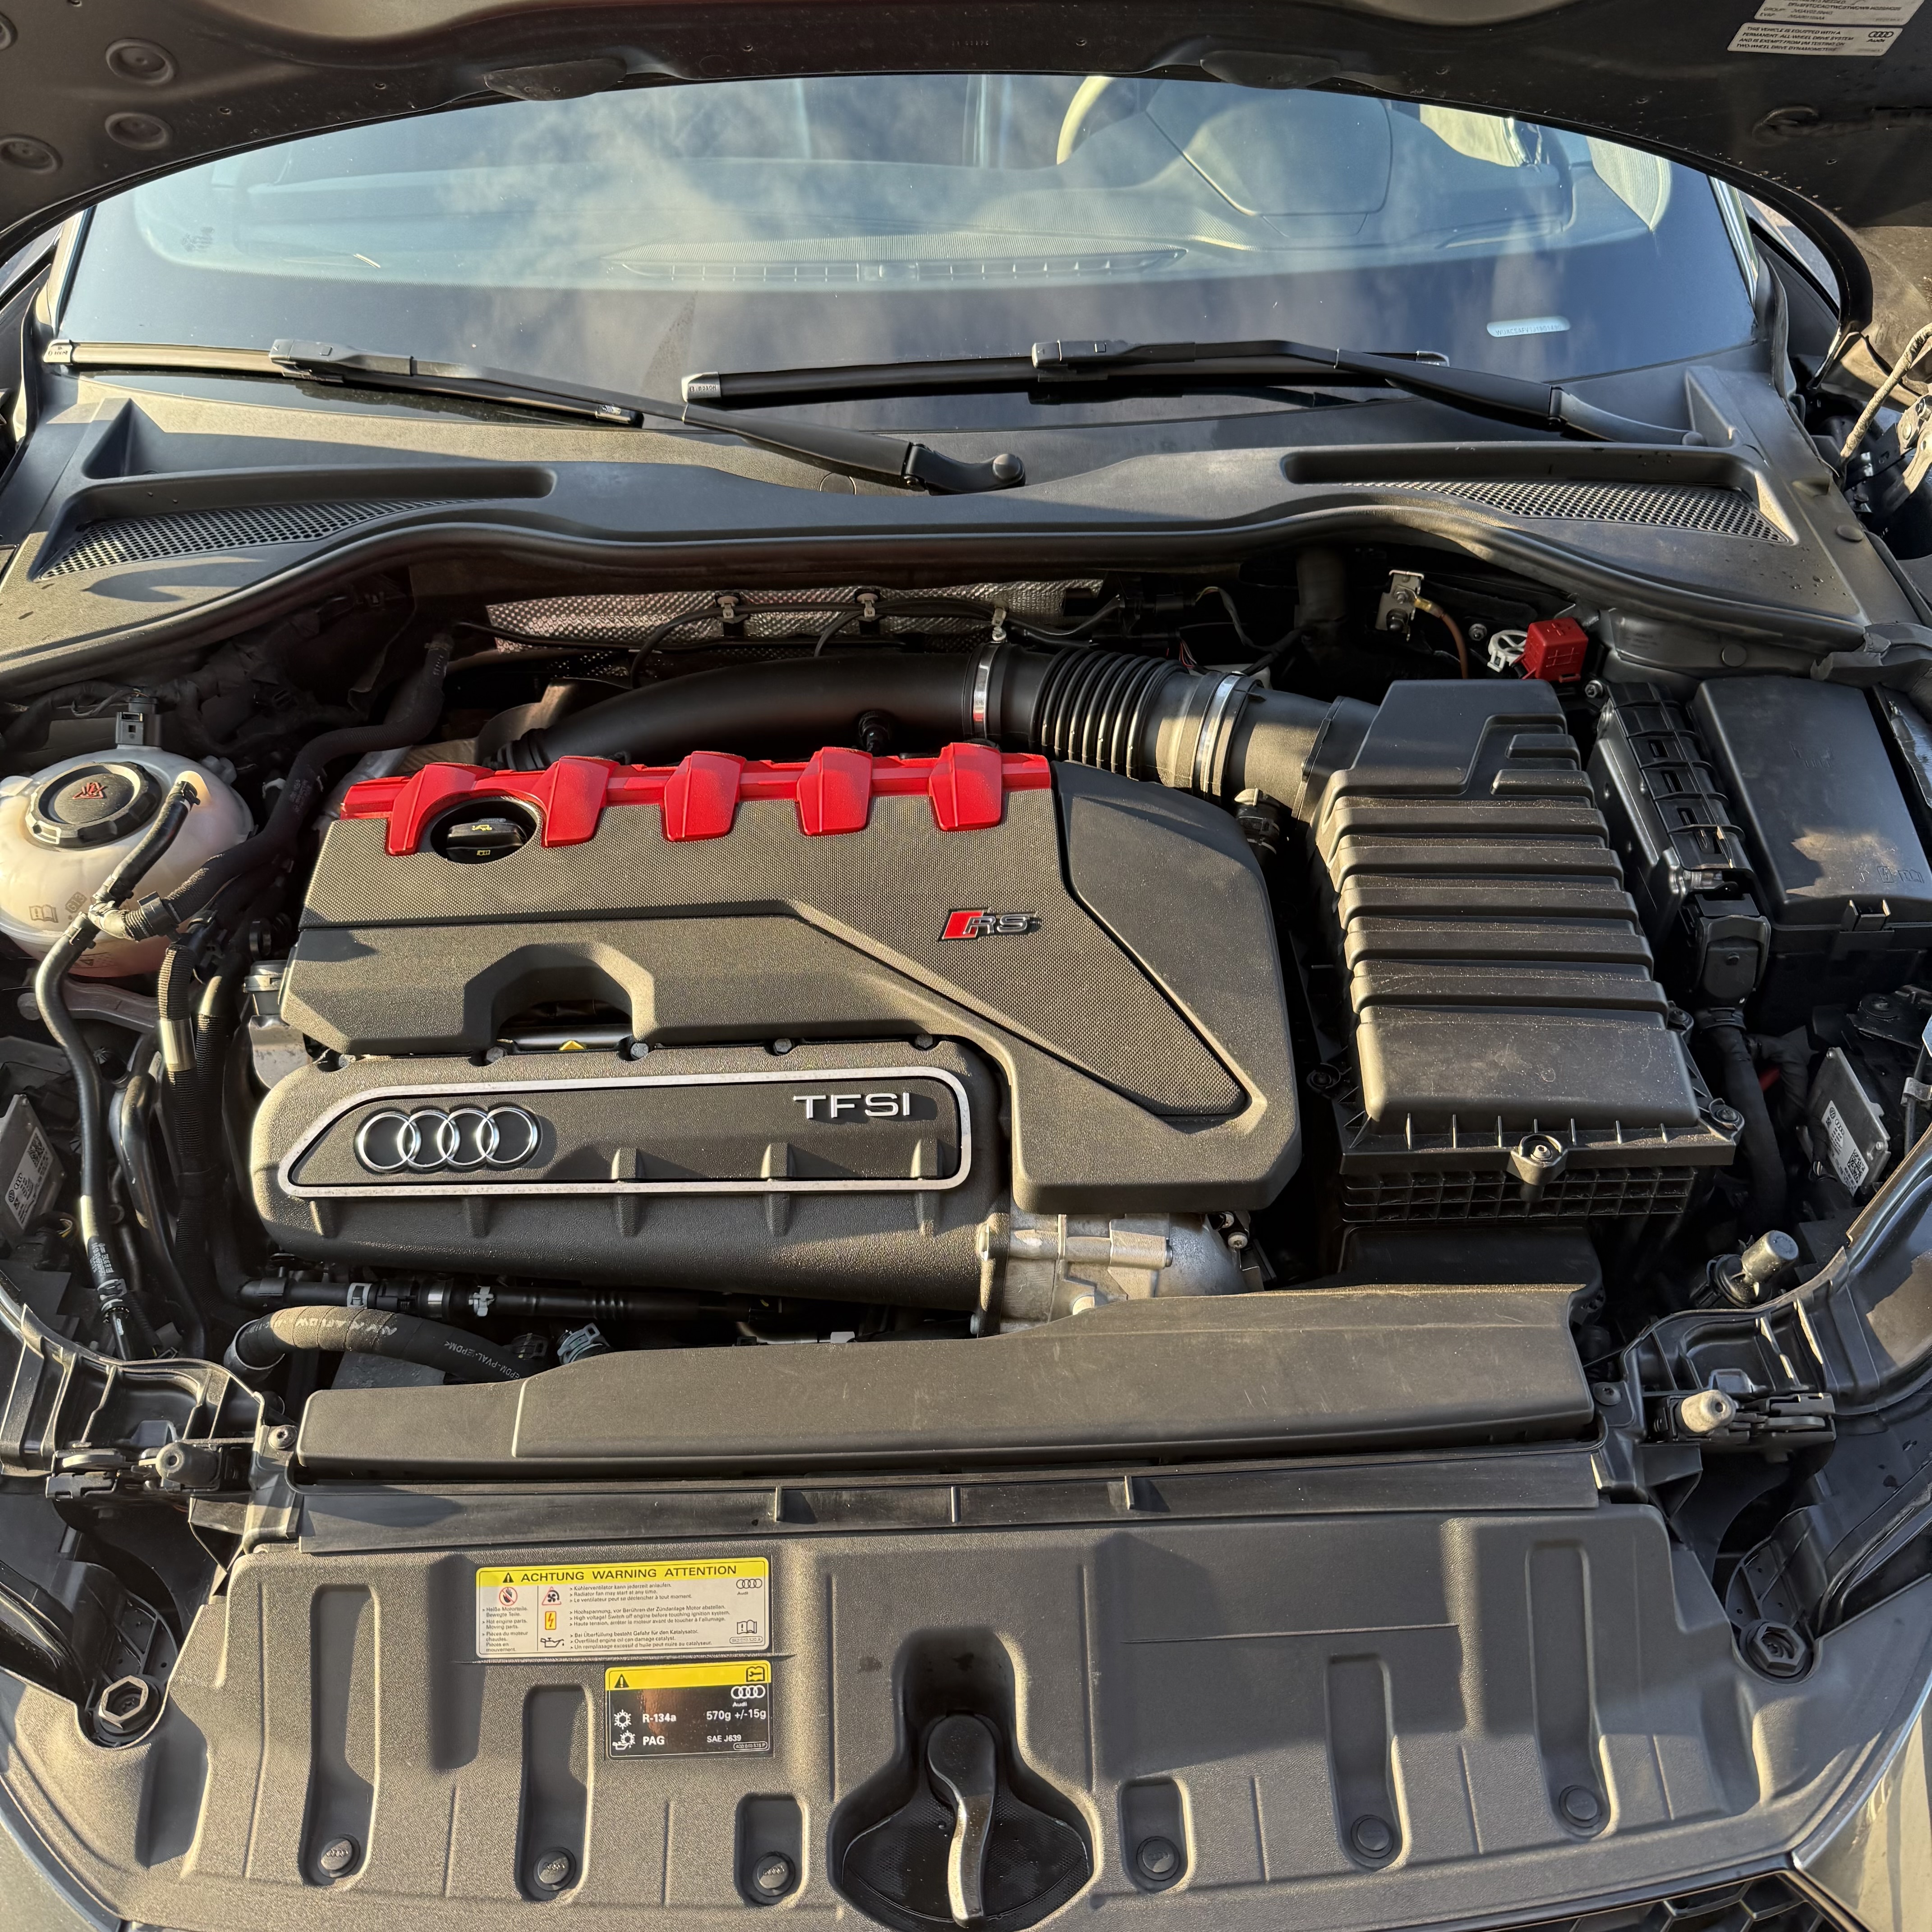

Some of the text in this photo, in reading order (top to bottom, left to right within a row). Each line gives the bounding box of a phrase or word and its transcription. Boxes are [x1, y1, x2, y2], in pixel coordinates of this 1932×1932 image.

[68, 893, 85, 912] G13
[962, 915, 1030, 935] RS
[793, 1092, 910, 1119] TFSI
[521, 1565, 737, 1582] ACHTUNG WARNING ATTENTION
[642, 1709, 767, 1723] R-134a 570g +/-15g
[643, 1736, 665, 1746] PAG
